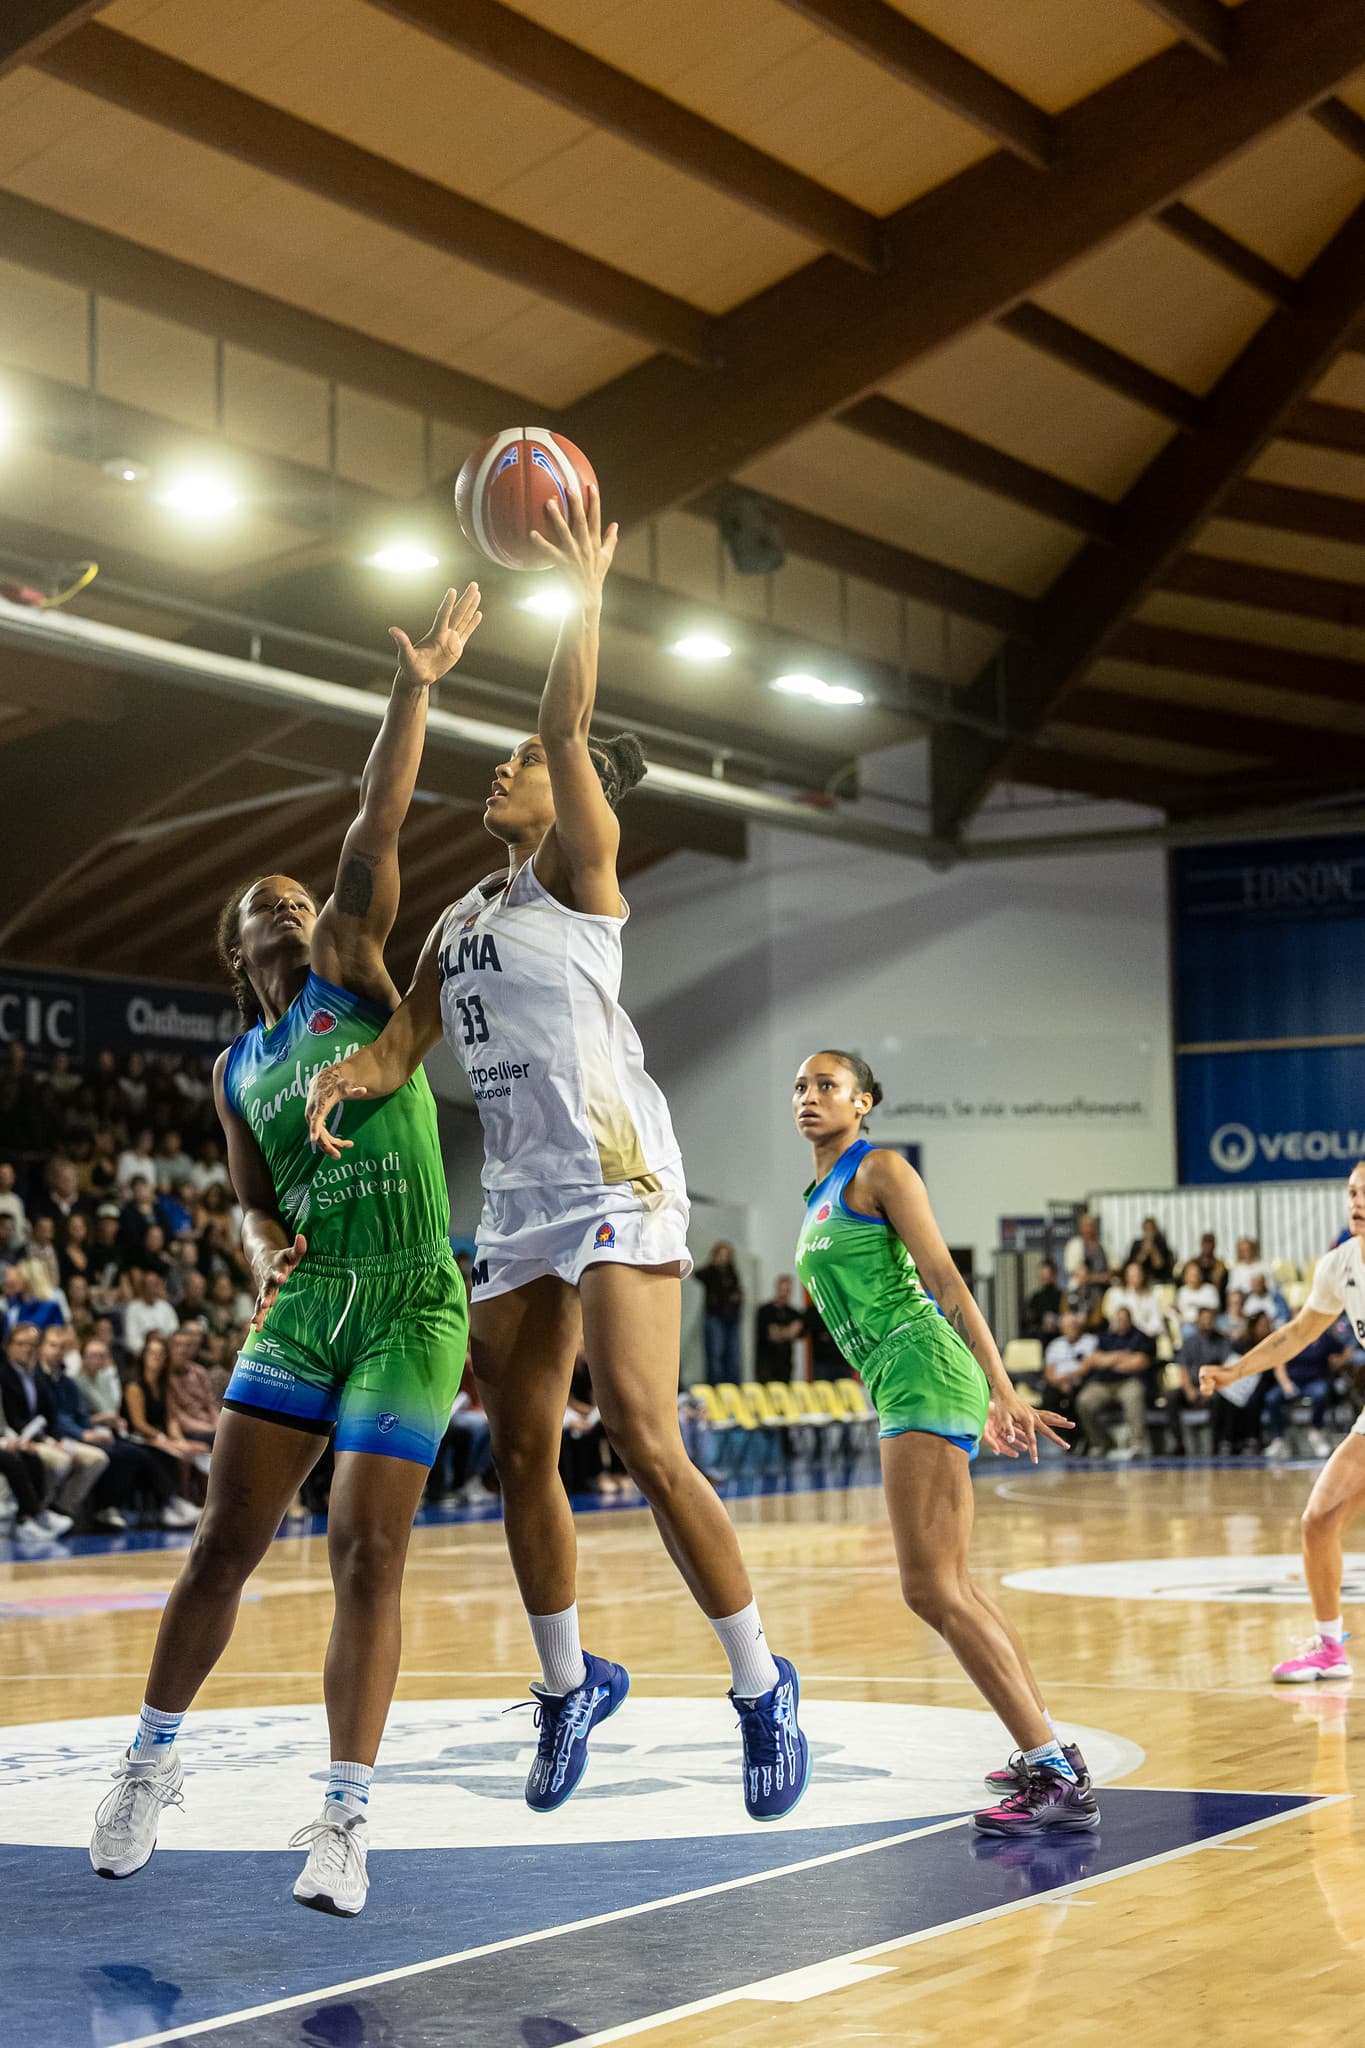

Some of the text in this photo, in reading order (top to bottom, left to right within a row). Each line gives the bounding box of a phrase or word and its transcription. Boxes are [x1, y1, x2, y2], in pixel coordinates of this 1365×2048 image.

[456, 995, 490, 1046] 33
[312, 1151, 400, 1189] Banco di
[316, 1178, 407, 1210] Sardegna
